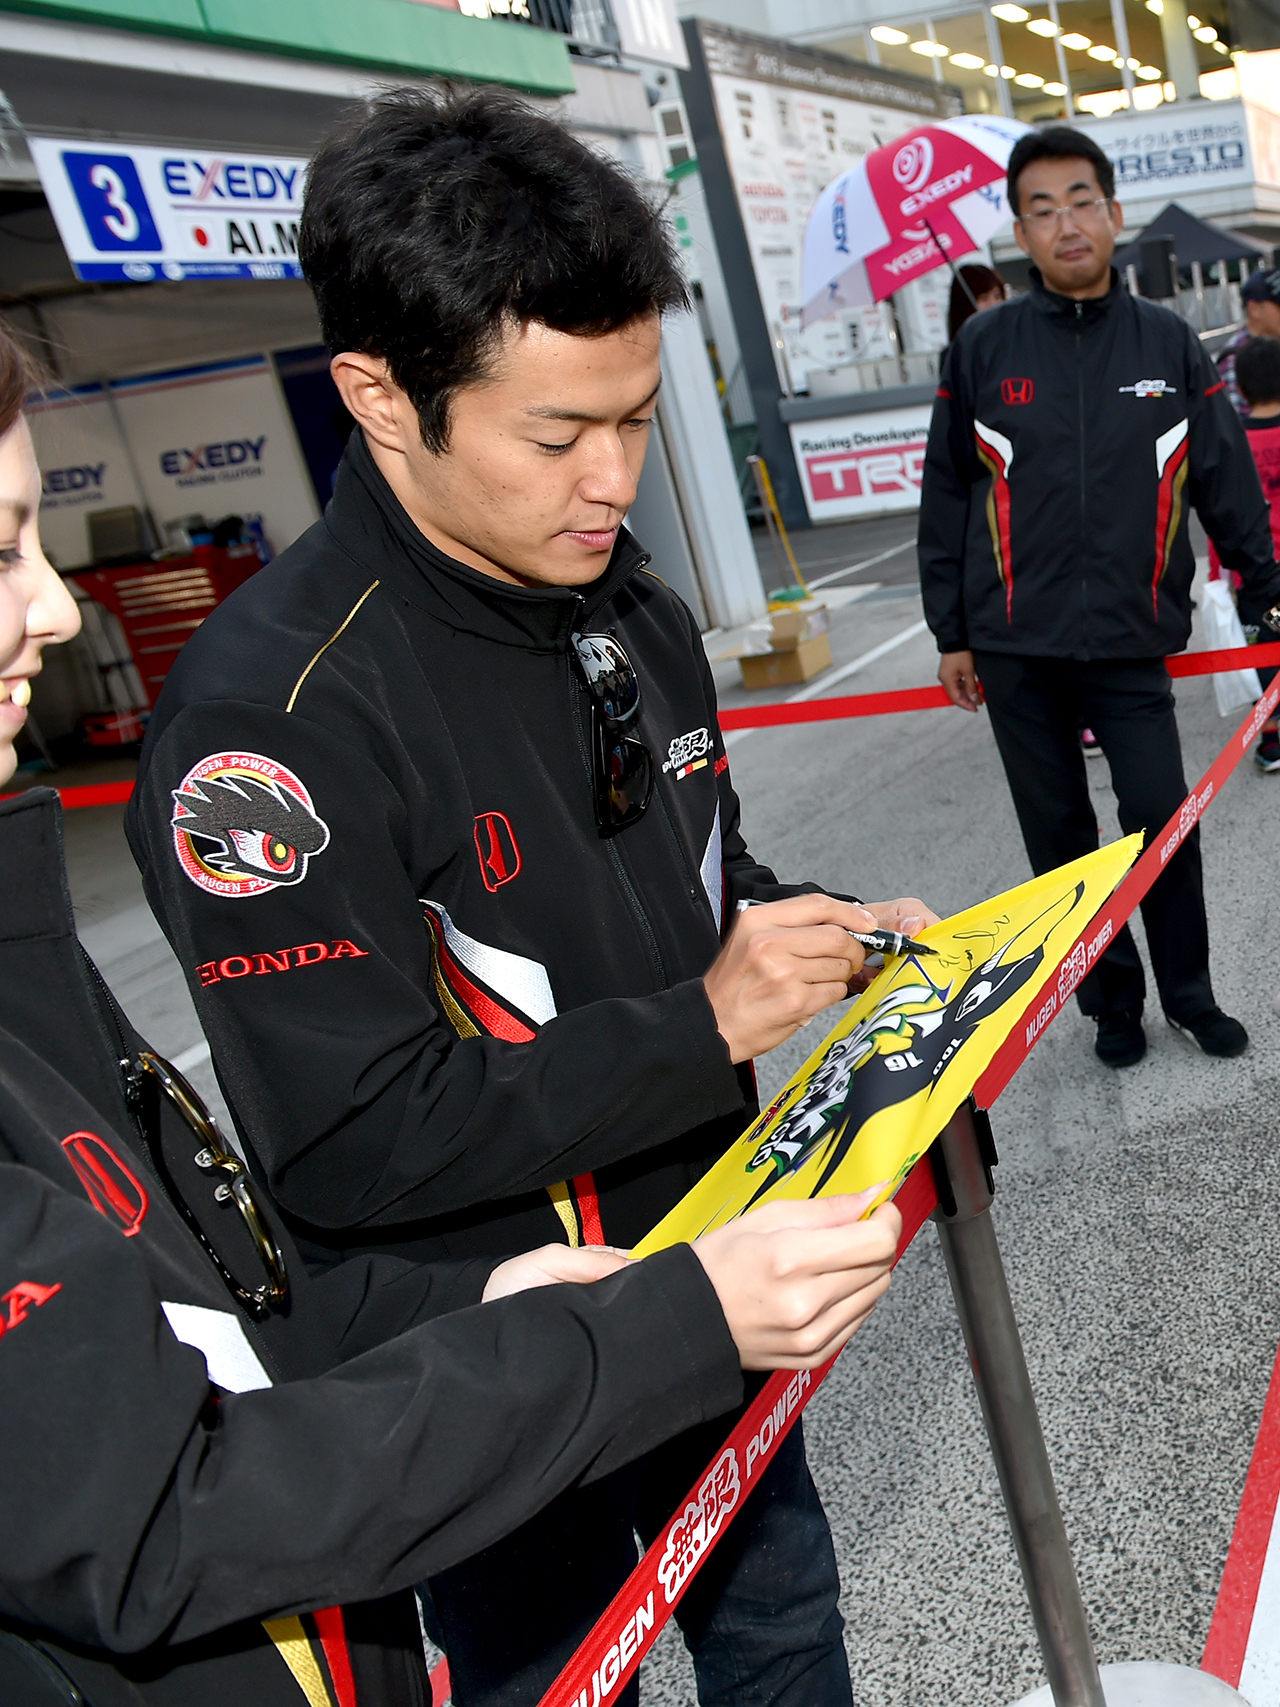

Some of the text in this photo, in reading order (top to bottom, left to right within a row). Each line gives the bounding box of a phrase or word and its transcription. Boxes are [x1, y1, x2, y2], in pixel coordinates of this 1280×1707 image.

[1113, 140, 1243, 174] RESTO
[162, 159, 297, 201] EXEDY
[900, 164, 973, 216] EXEDY
[89, 163, 141, 242] 3
[160, 434, 267, 477] EXEDY
[801, 427, 928, 452] Racing Developm
[41, 461, 106, 495] EDY
[194, 757, 278, 778] UGEN POWER
[199, 873, 242, 893] MUGEN
[195, 939, 370, 988] HONDA
[1025, 991, 1057, 1047] MUGEN
[1087, 919, 1113, 966] POWER
[746, 1369, 812, 1481] POWER
